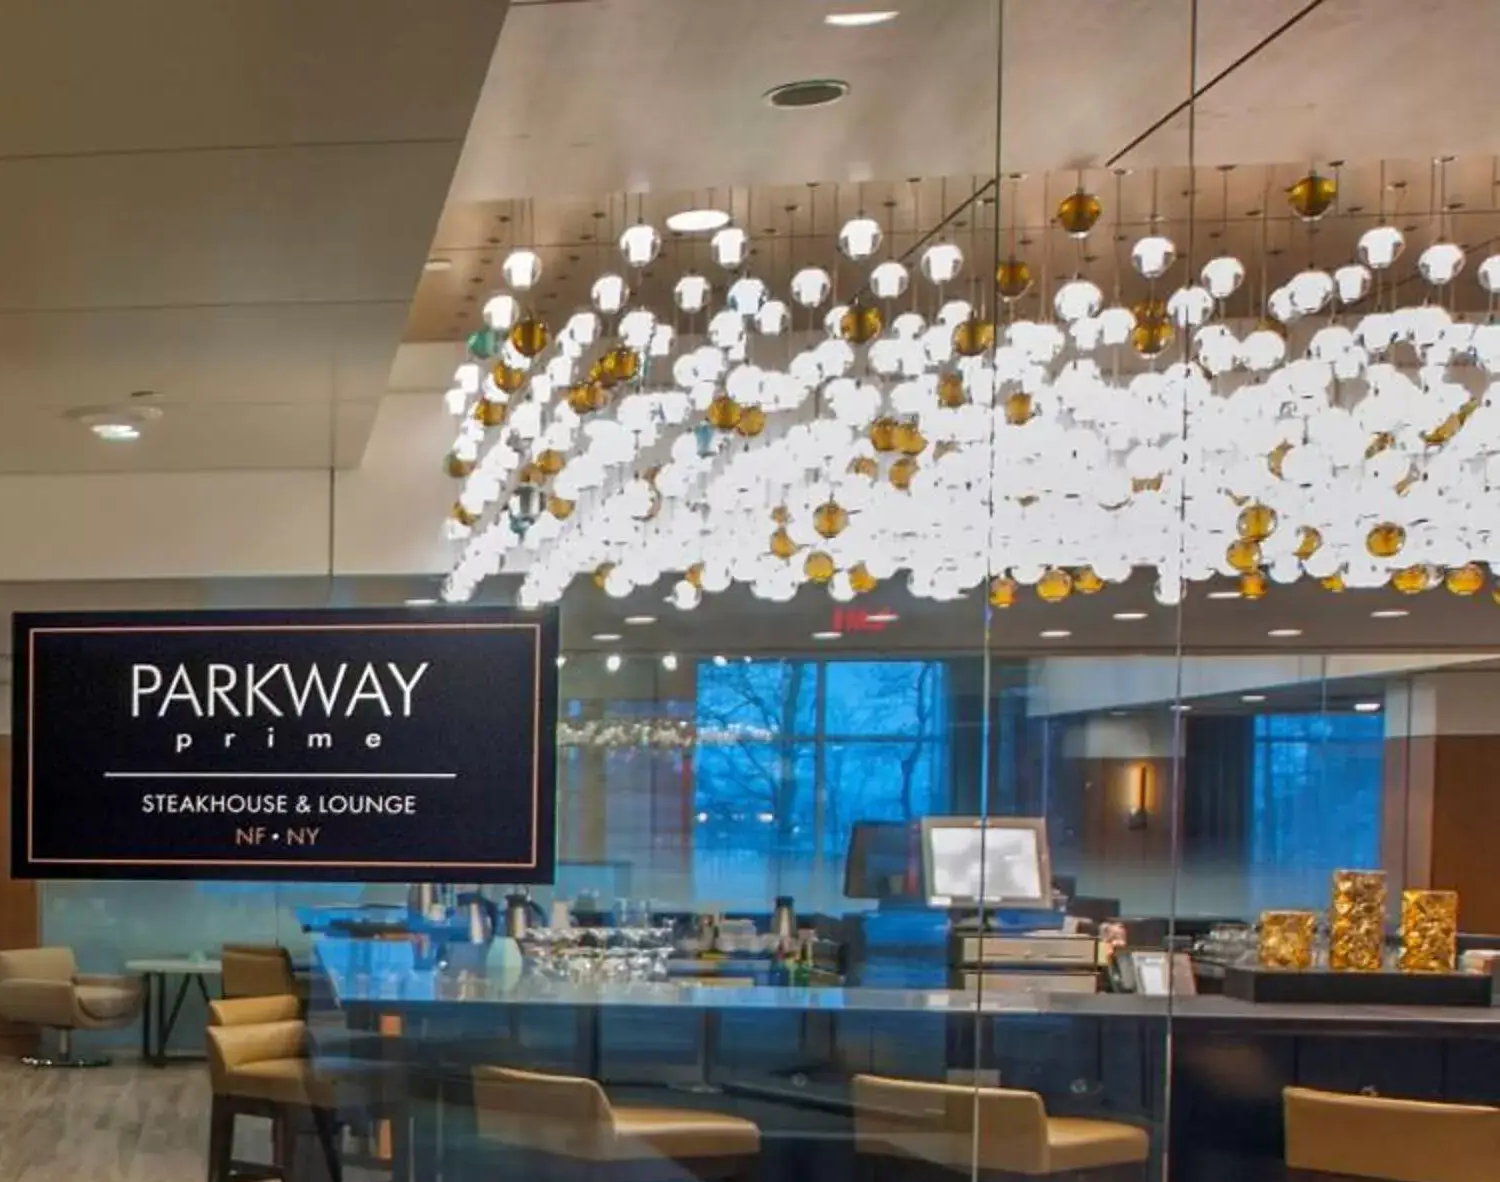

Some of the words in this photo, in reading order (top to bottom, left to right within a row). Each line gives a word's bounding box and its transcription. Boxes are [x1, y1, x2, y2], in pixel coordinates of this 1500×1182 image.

[131, 662, 430, 718] PARKWAY
[175, 726, 382, 753] prime
[141, 793, 288, 813] STEAKHOUSE
[295, 794, 312, 813] &
[318, 794, 416, 814] LOUNGE
[235, 826, 266, 845] NF
[287, 826, 320, 845] NY
